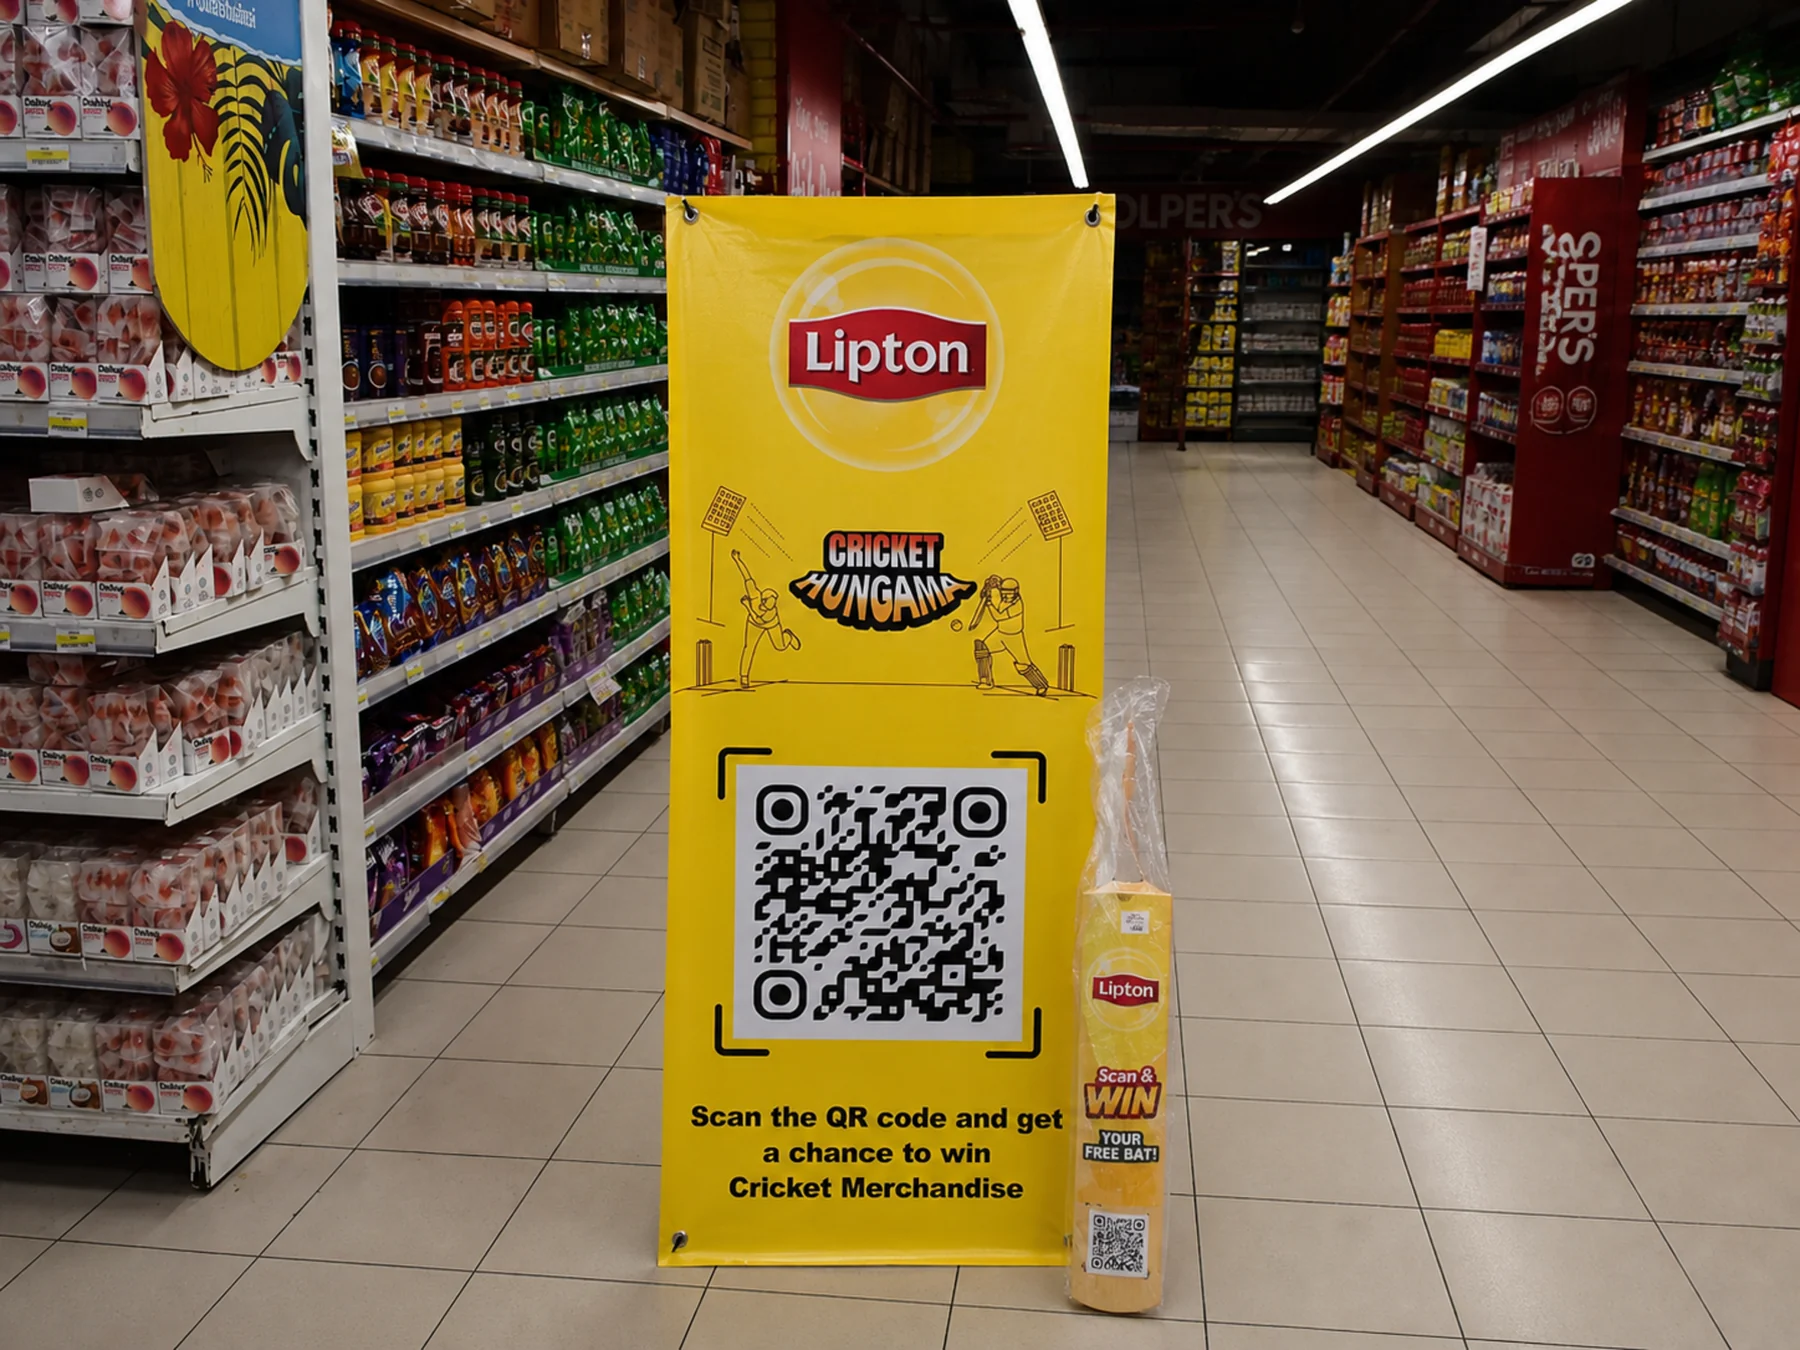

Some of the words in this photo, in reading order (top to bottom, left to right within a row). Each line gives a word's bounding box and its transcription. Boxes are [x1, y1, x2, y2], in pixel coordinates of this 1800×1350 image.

[806, 328, 968, 383] Lipton
[829, 533, 939, 568] CRICKET
[795, 573, 972, 623] HUNGAMA
[1099, 981, 1154, 999] Lipton
[1098, 1068, 1137, 1083] Scan
[1140, 1067, 1154, 1083] &
[1086, 1085, 1160, 1116] WIN
[691, 1105, 761, 1127] Scan
[771, 1106, 817, 1127] the
[826, 1106, 868, 1129] QR
[877, 1106, 947, 1128] code
[956, 1107, 1008, 1129] and
[1017, 1108, 1063, 1135] get
[1101, 1131, 1142, 1146] YOUR
[763, 1147, 780, 1163] a
[789, 1142, 893, 1163] chance
[903, 1142, 931, 1163] to
[941, 1142, 991, 1163] win
[1084, 1145, 1120, 1160] FREE
[1123, 1147, 1158, 1161] BAT!
[729, 1176, 832, 1198] Cricket
[841, 1176, 1024, 1199] Merchandise
